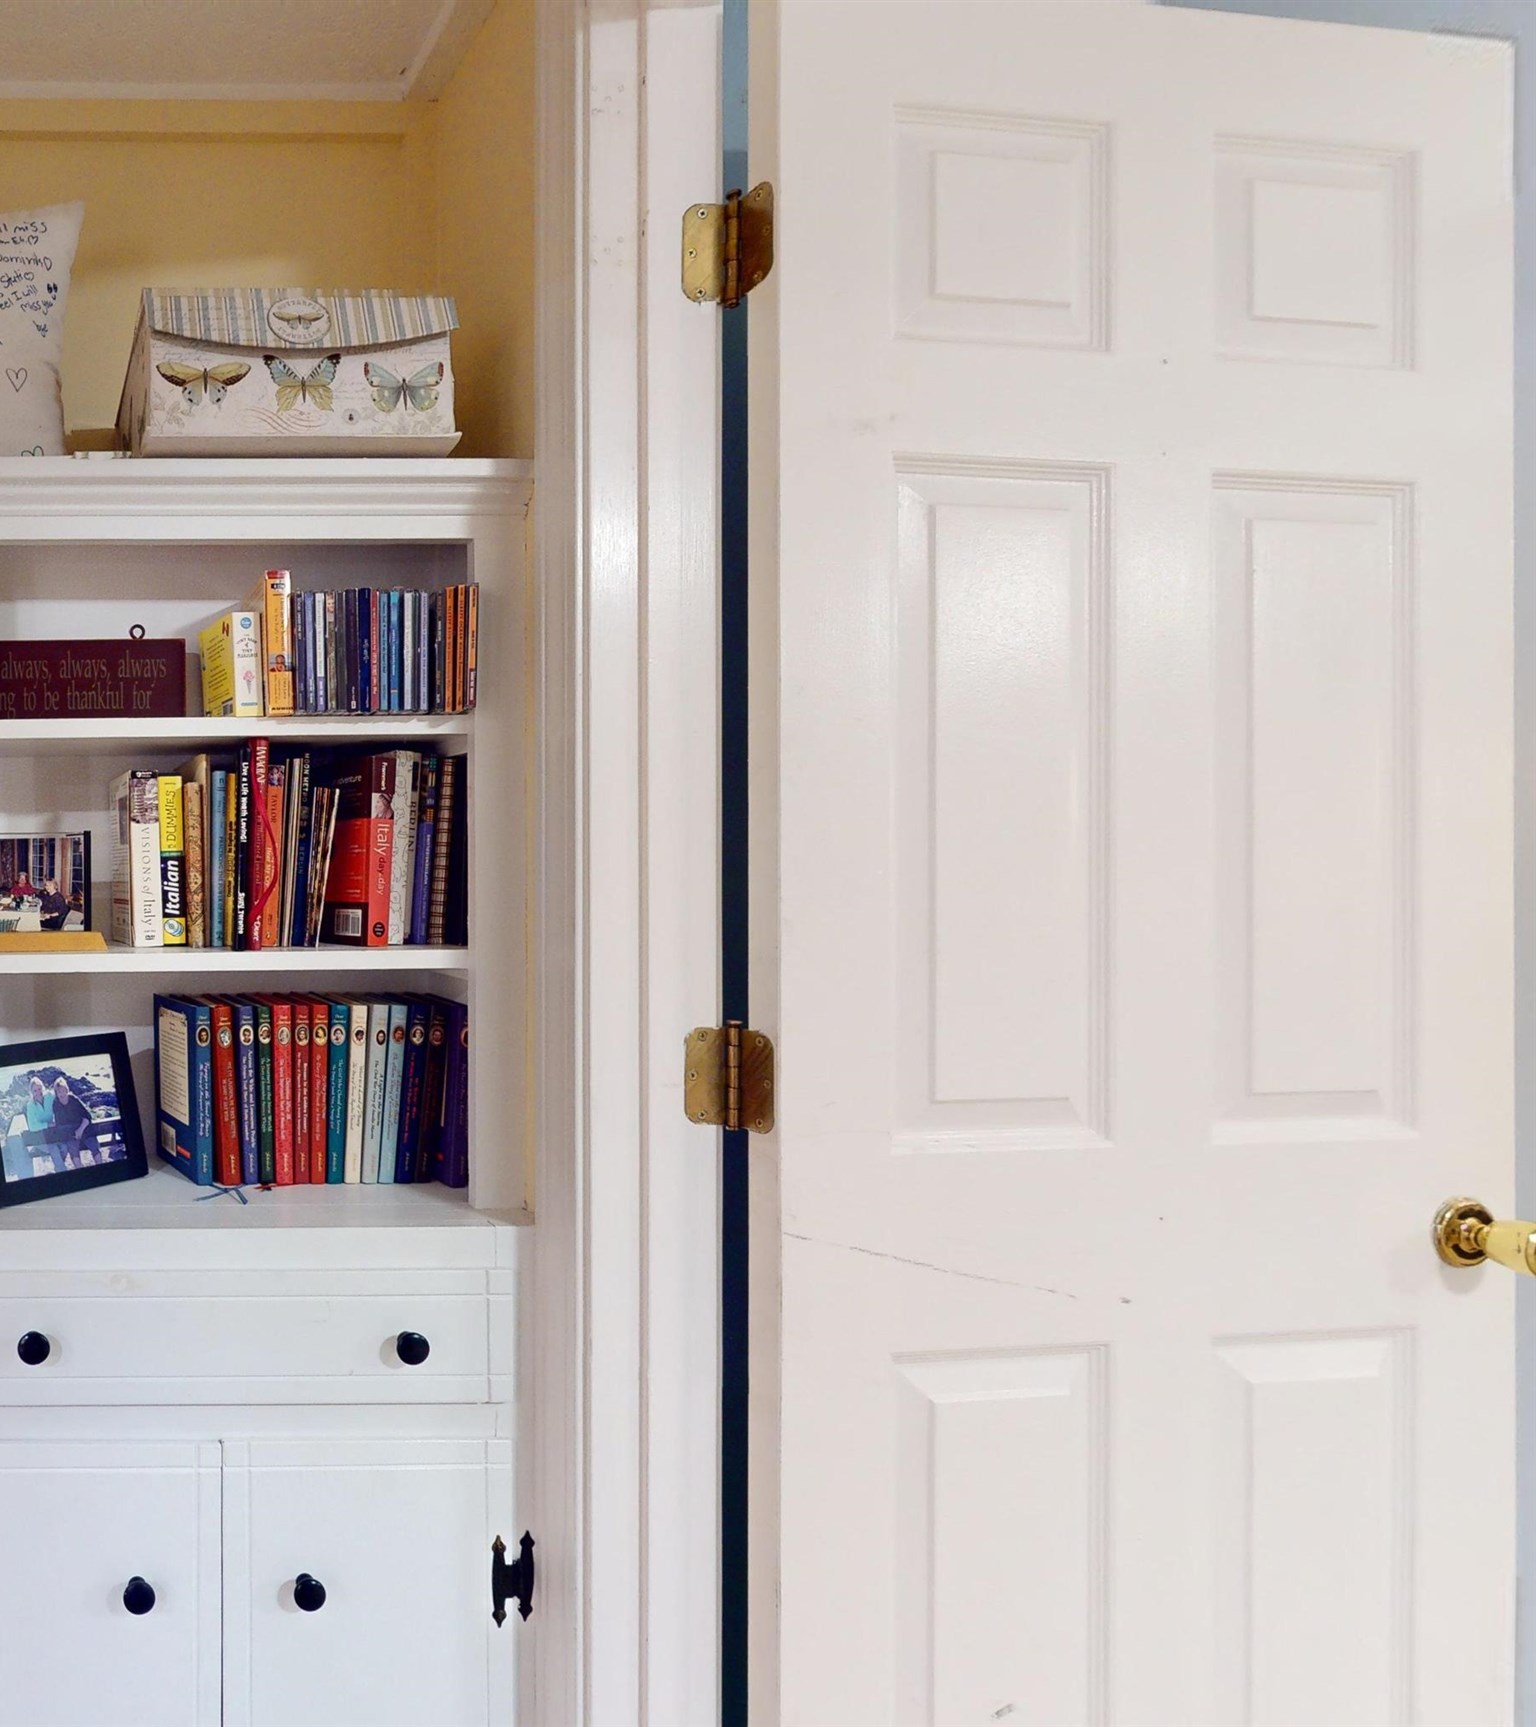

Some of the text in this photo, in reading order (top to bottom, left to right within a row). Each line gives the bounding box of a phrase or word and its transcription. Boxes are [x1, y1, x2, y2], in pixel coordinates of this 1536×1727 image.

[13, 221, 47, 233] miss
[0, 651, 54, 688] always,
[59, 650, 112, 688] always,
[118, 649, 167, 688] always
[22, 687, 38, 711] to
[43, 682, 61, 711] be
[66, 680, 126, 711] thankful
[132, 681, 155, 711] for
[241, 762, 249, 776] Live
[165, 789, 177, 845] DUMMIES
[240, 797, 248, 817] Worth
[141, 826, 152, 883] VISIONS
[373, 823, 390, 856] Italy
[164, 860, 180, 915] Italian
[141, 898, 156, 926] Italy
